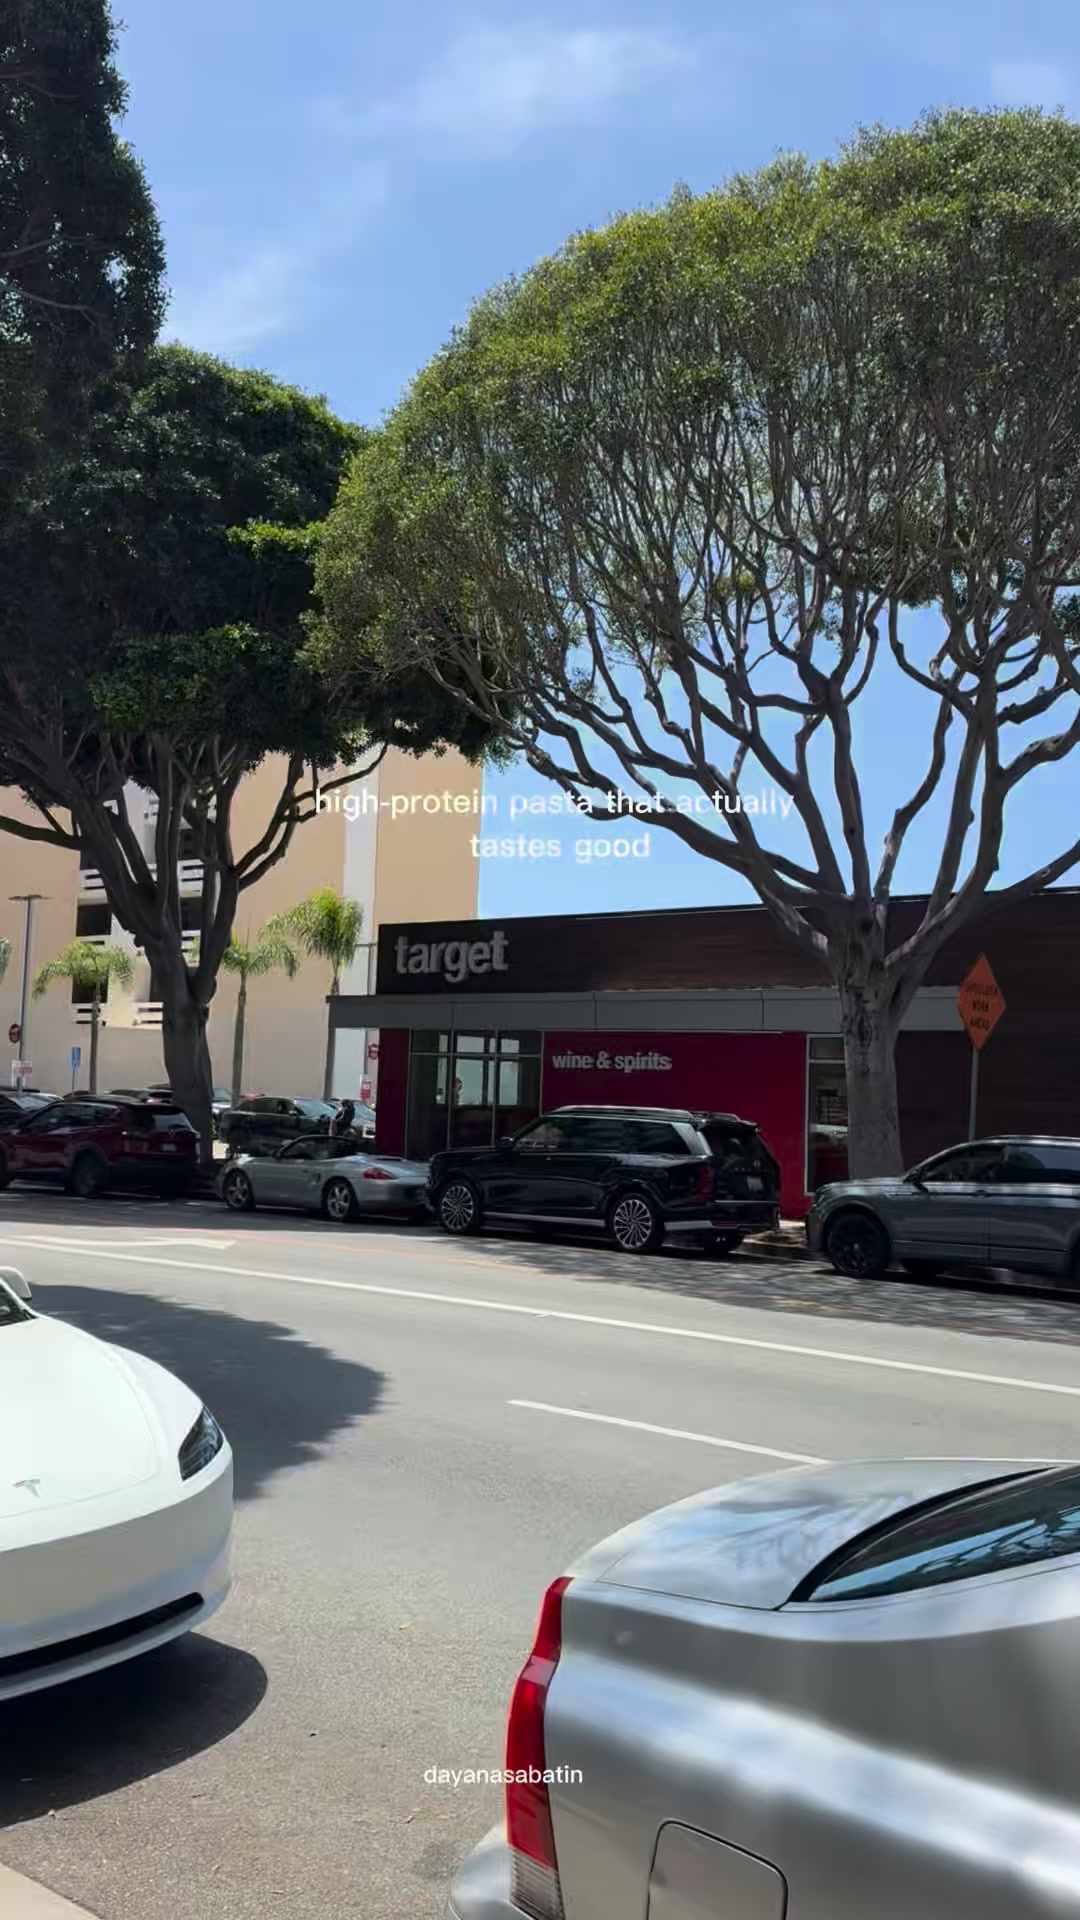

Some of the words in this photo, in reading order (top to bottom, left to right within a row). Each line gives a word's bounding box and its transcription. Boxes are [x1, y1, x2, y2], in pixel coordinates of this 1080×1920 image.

[395, 931, 509, 984] target
[552, 1051, 594, 1070] wine
[596, 1051, 612, 1070] &
[614, 1051, 673, 1074] spirits
